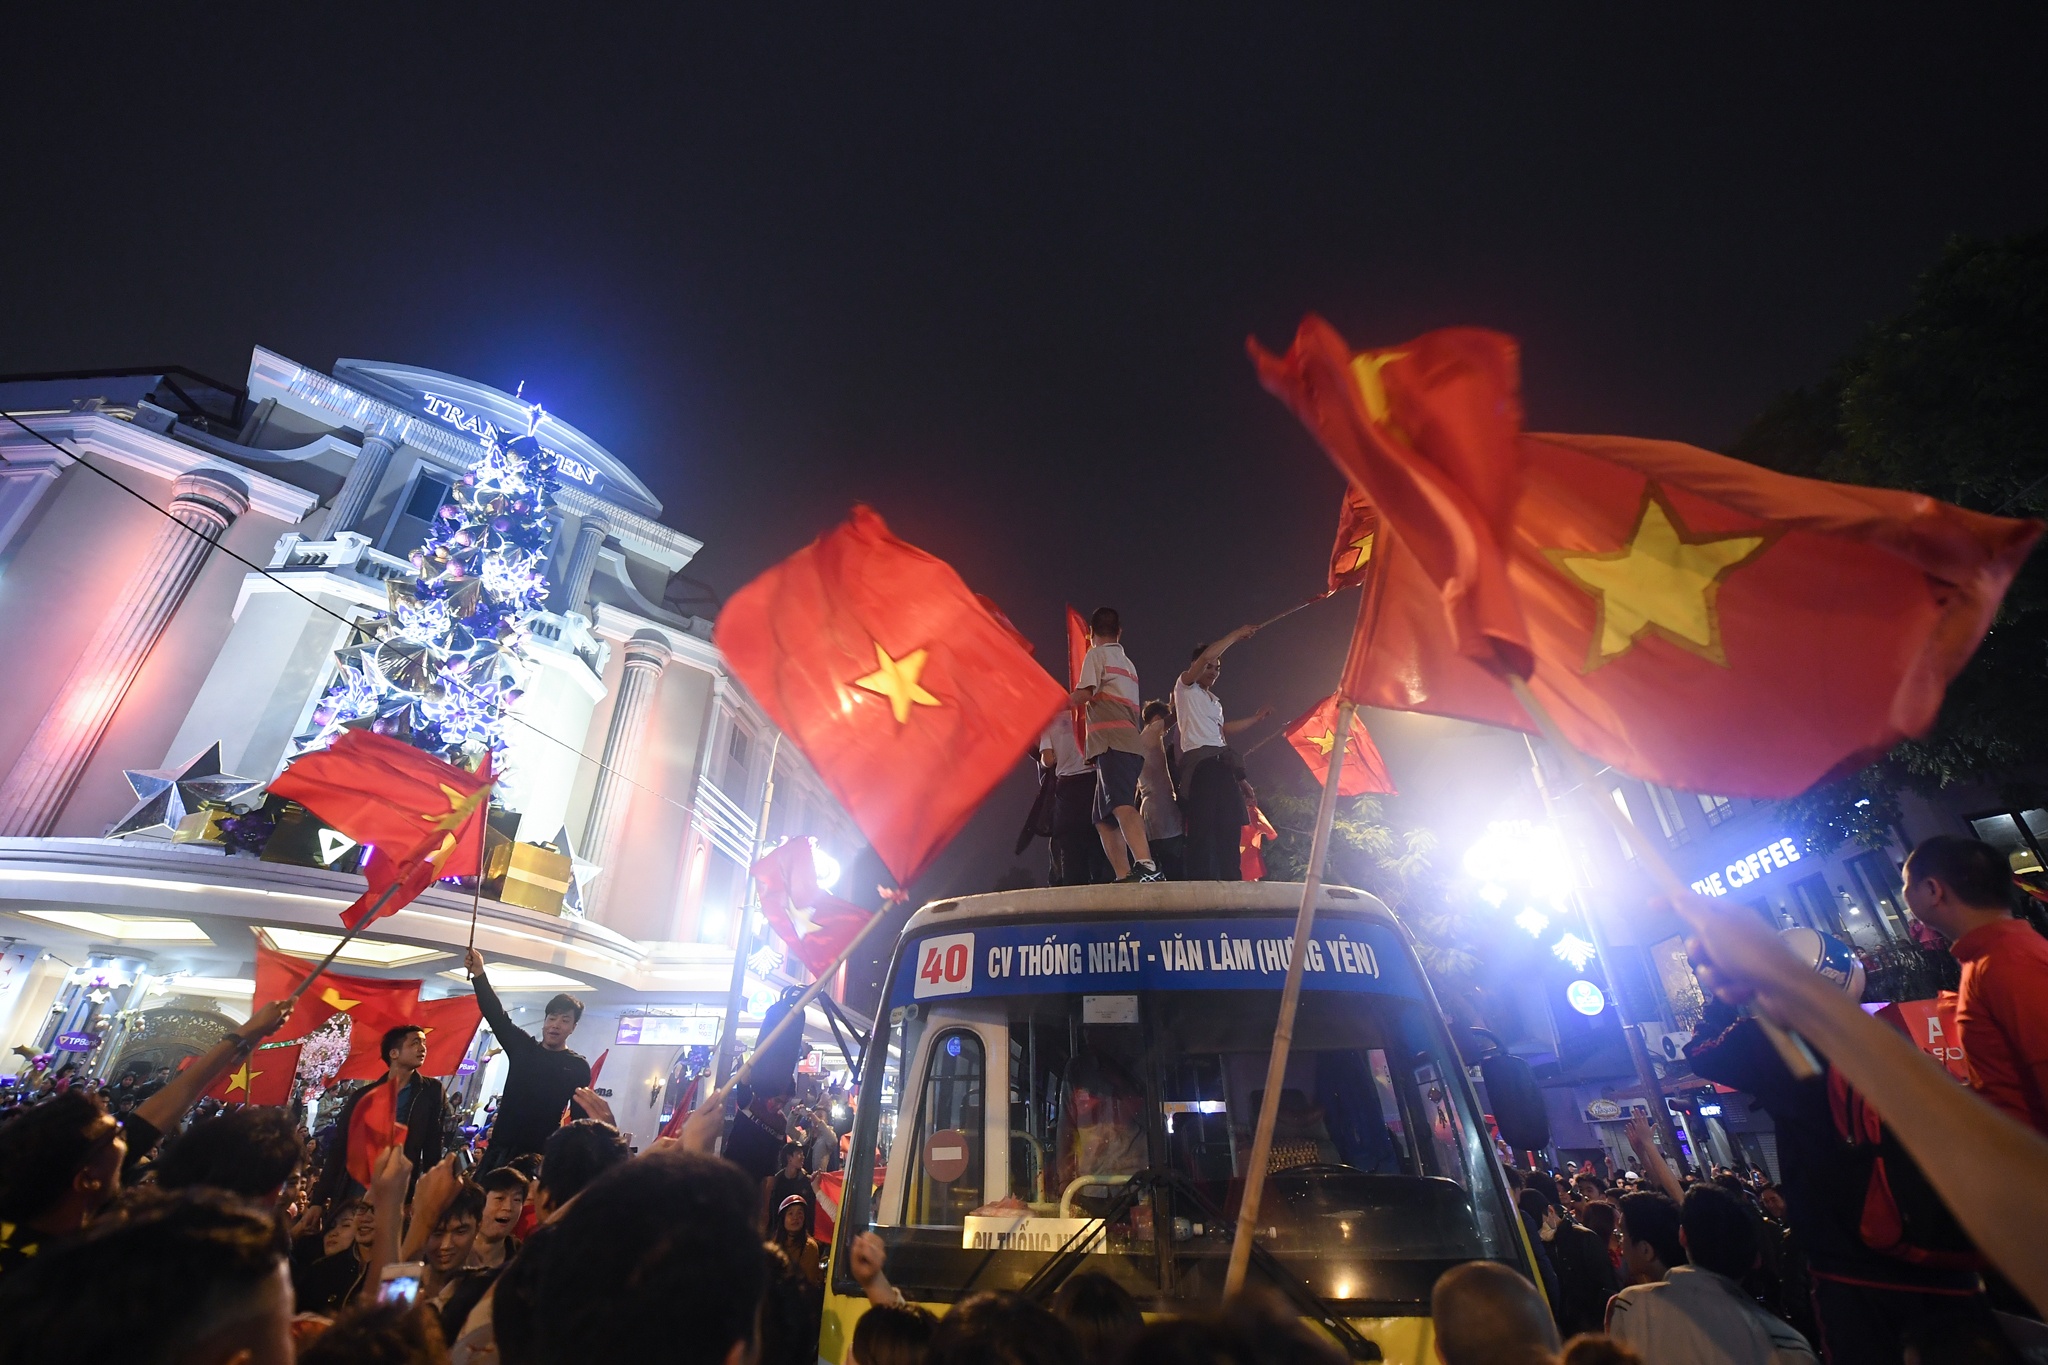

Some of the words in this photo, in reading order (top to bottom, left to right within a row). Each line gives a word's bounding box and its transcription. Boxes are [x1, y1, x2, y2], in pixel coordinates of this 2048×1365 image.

[424, 393, 510, 441] TRAN
[1690, 871, 1728, 897] THE
[1725, 837, 1801, 888] COFFEE
[920, 943, 969, 984] 40
[988, 945, 1013, 978] CV
[1018, 934, 1082, 976] THỐNG
[1088, 931, 1141, 973] NHẤT
[1159, 932, 1202, 972] VĂN
[1207, 932, 1256, 971] LÂM
[1256, 936, 1326, 975] (HƯG
[1325, 933, 1380, 980] YÊN)
[69, 1037, 98, 1046] TPBank
